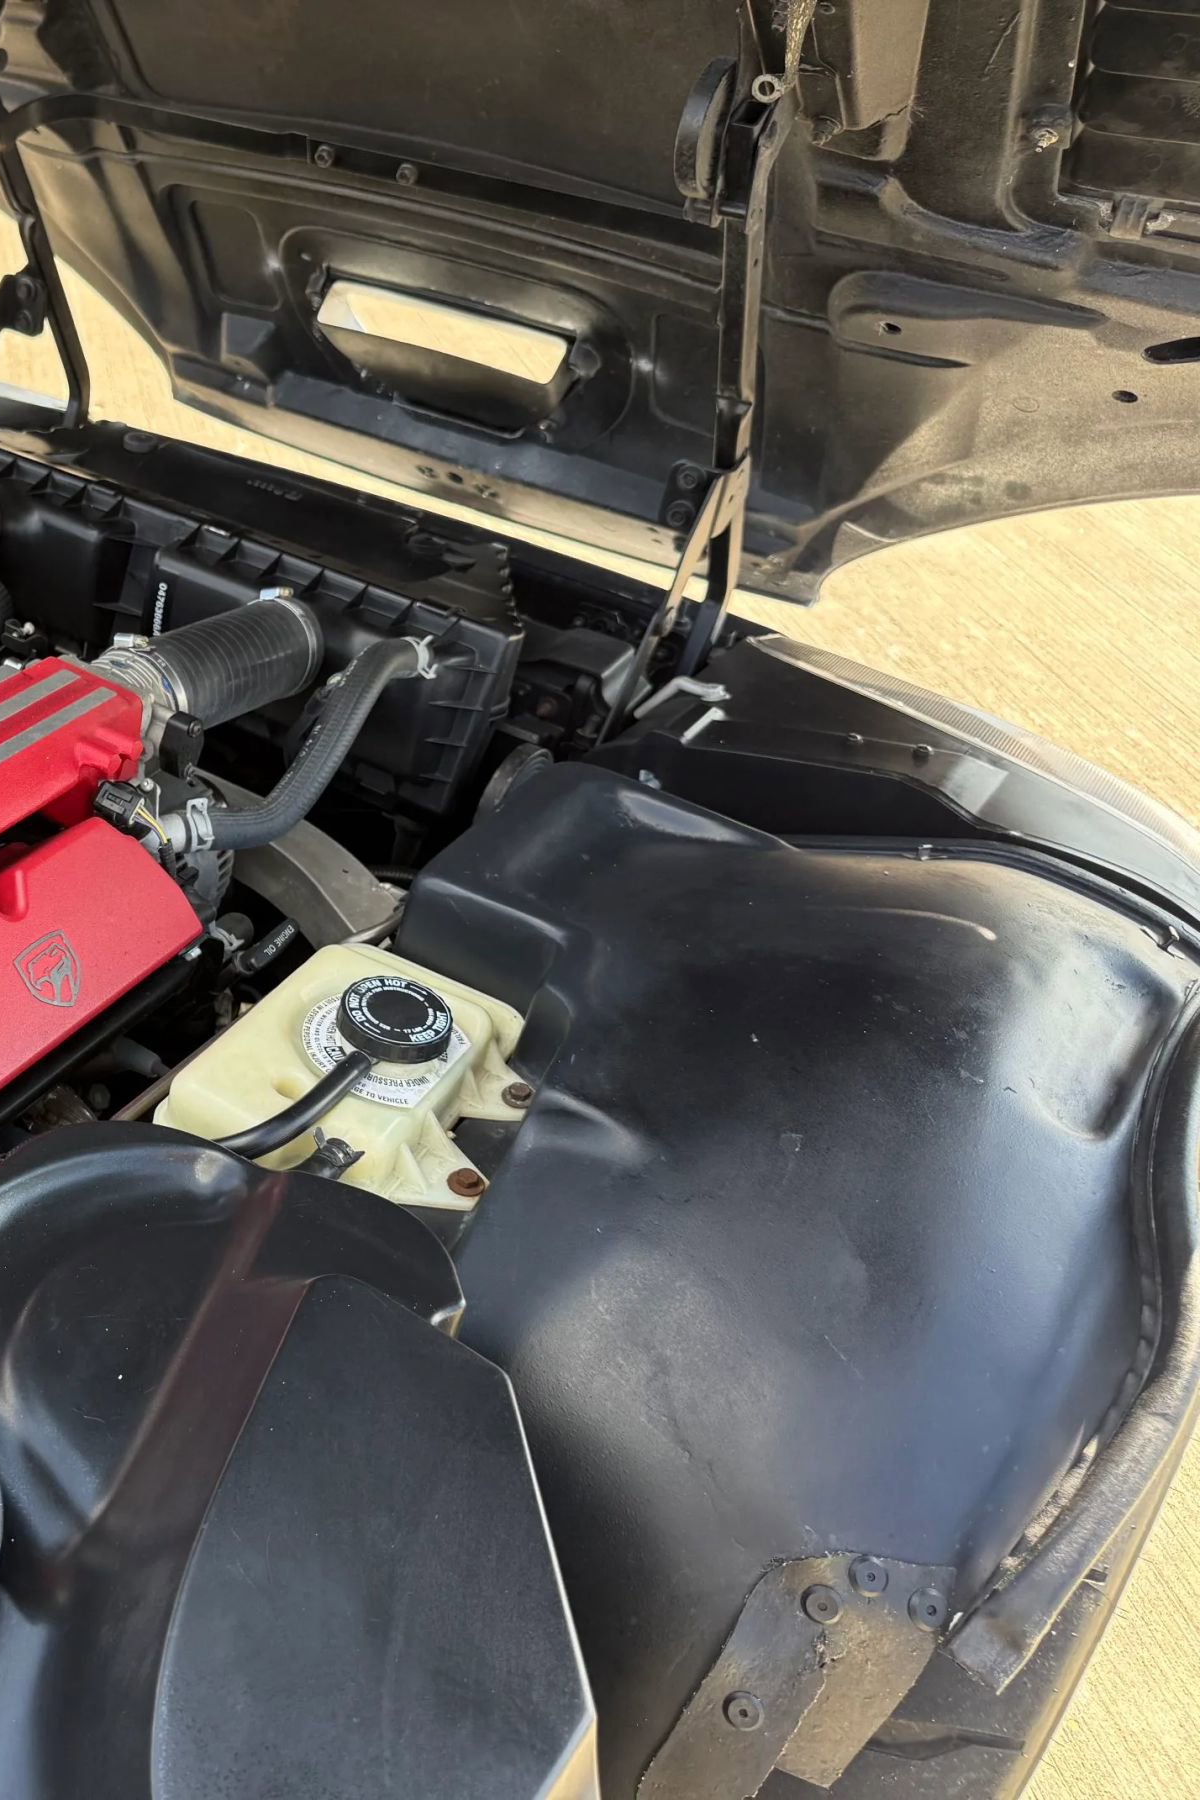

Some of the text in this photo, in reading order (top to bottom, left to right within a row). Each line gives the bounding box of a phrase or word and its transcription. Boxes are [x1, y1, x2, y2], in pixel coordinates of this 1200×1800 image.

[263, 924, 295, 956] ENGINE OIL
[383, 978, 408, 988] HOT
[348, 992, 361, 1009] NOT
[304, 1008, 320, 1026] SEVERE
[351, 1010, 367, 1023] DO
[408, 1029, 436, 1042] KEEP
[432, 1010, 448, 1032] TIGHT
[303, 1025, 313, 1051] PERSONAL
[310, 1051, 327, 1069] INJURY
[405, 1076, 430, 1088] UNDER
[379, 1094, 409, 1105] VEHICLE
